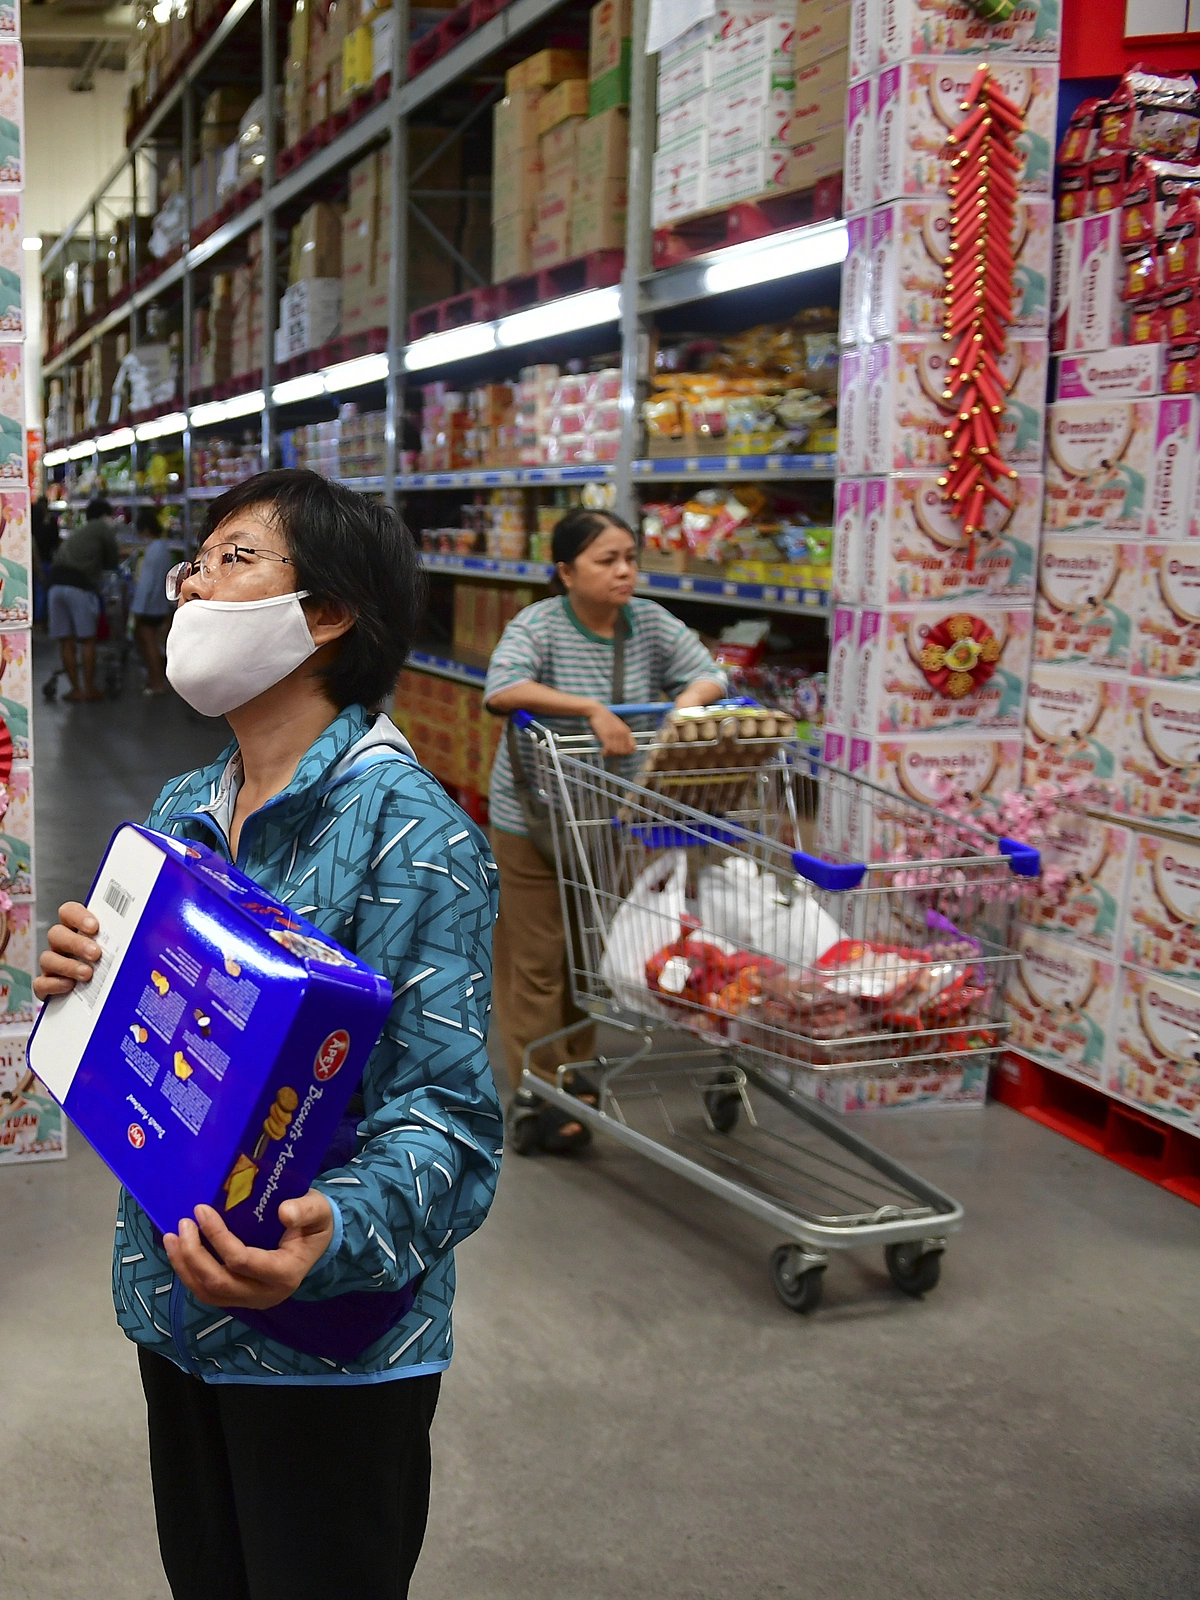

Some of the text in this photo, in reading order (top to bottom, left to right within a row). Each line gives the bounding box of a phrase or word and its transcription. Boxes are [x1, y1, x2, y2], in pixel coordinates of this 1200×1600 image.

[317, 1037, 347, 1075] APEX
[290, 1084, 324, 1140] Biscuits
[252, 1143, 295, 1222] Assortment
